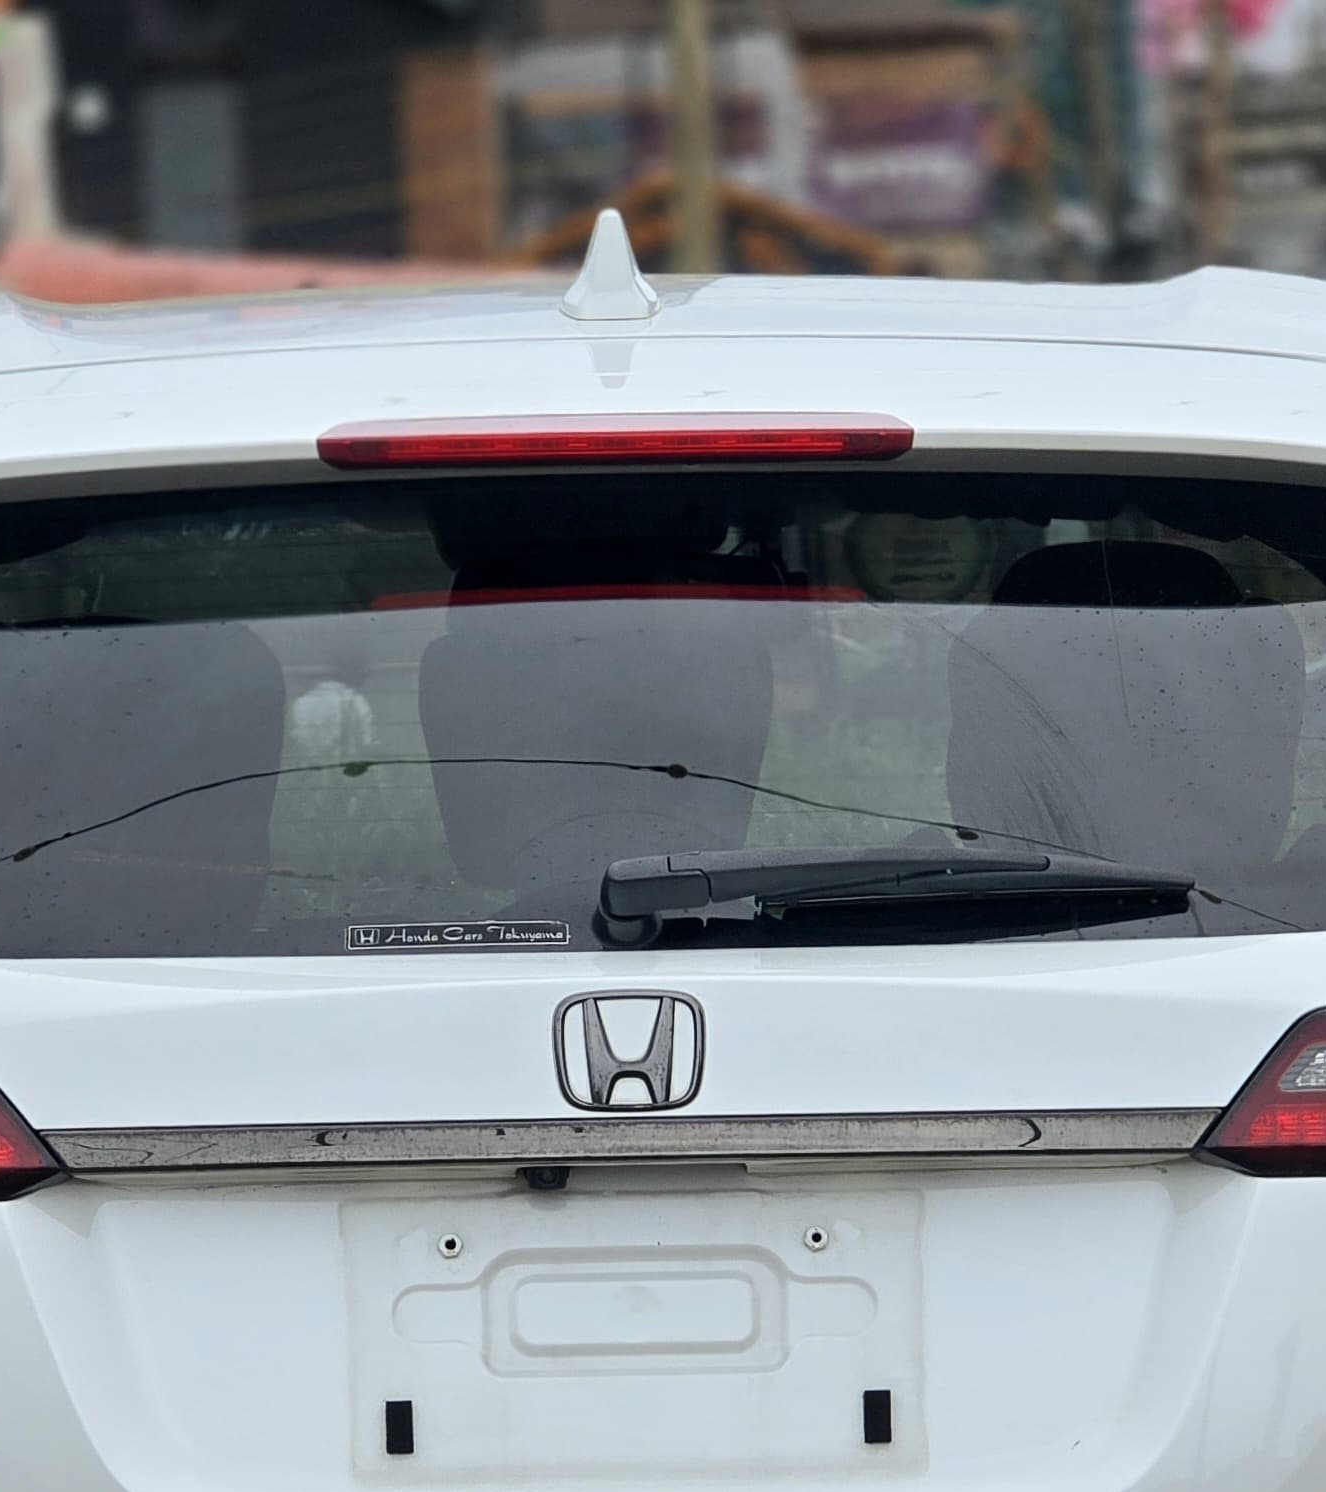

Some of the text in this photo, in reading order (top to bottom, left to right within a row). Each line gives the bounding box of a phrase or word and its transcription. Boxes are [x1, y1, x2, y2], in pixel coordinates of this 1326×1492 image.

[385, 928, 439, 943] Honda
[442, 926, 483, 941] Cars
[486, 925, 564, 942] Tokuyama
